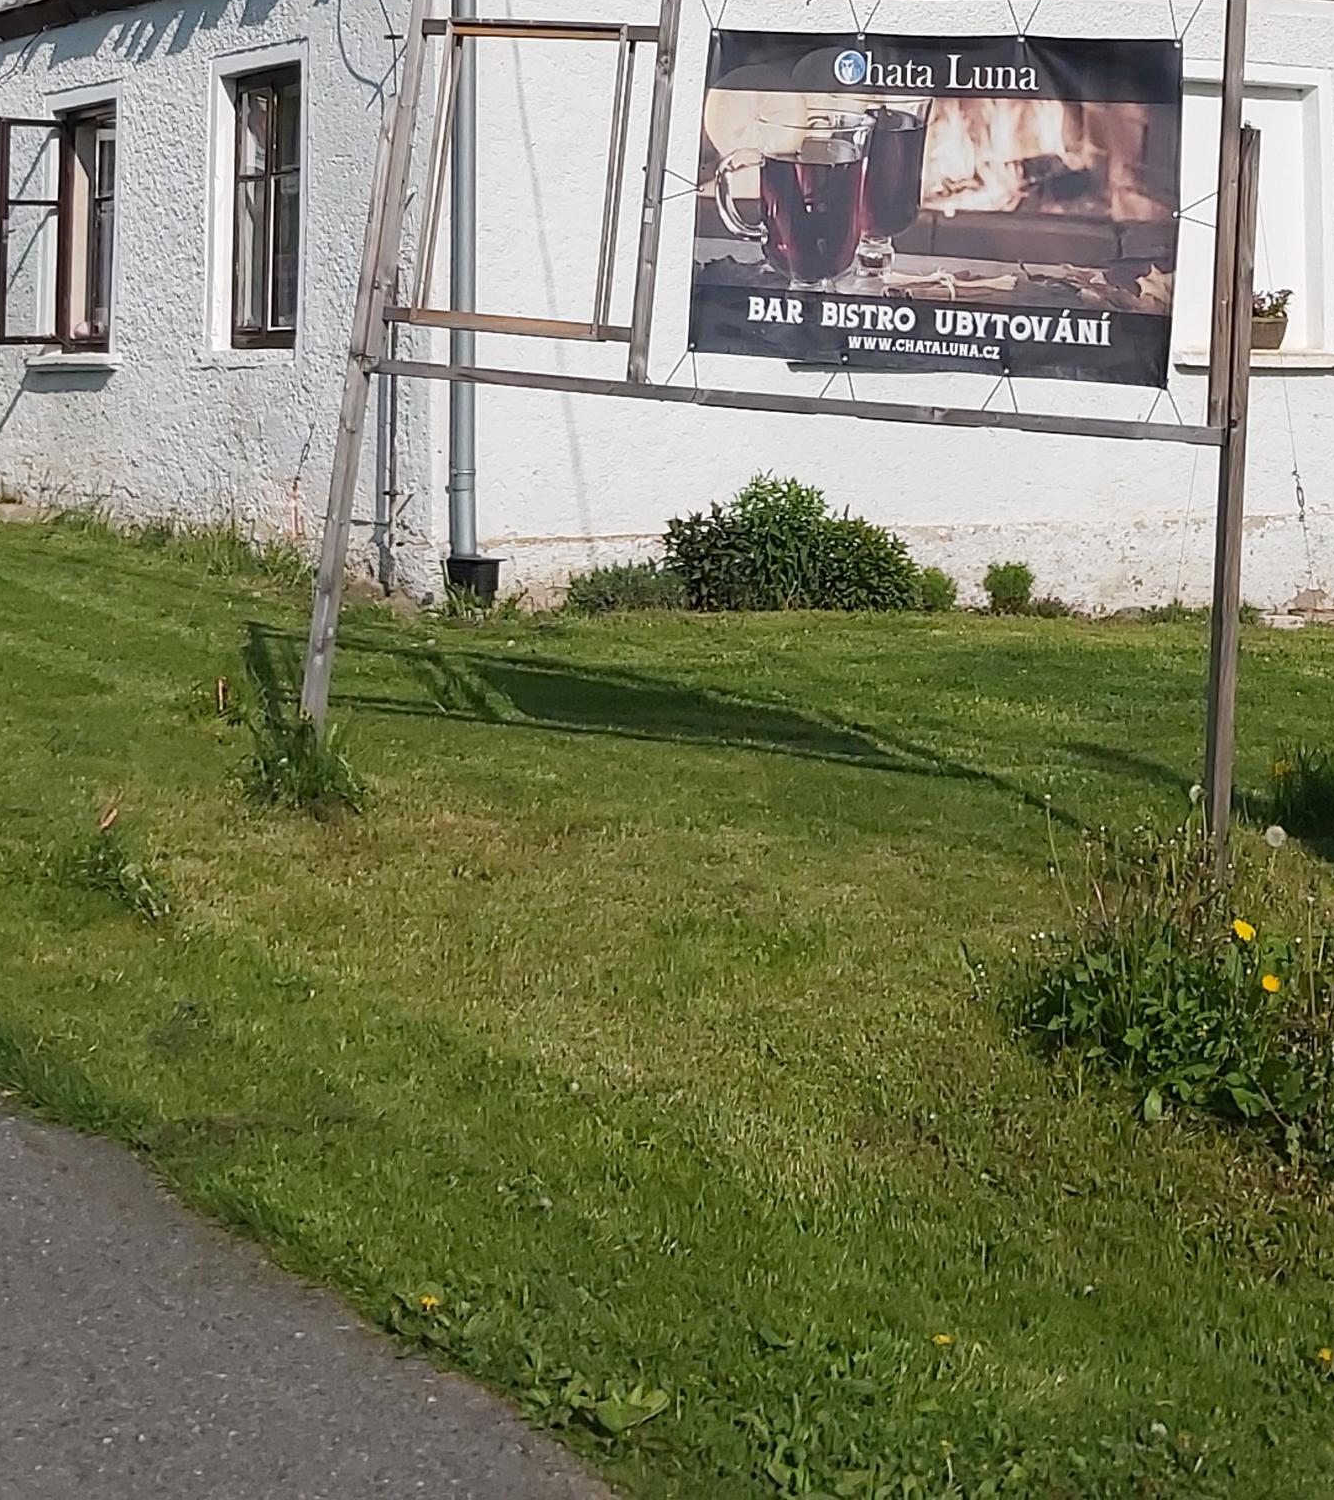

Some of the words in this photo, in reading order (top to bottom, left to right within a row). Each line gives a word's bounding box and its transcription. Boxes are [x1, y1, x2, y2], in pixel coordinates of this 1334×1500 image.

[945, 54, 1040, 91] Luna
[747, 296, 804, 324] BAR
[820, 301, 916, 332] BISTRO
[934, 309, 1112, 347] UBYTOVÁNÍ
[847, 335, 1001, 360] WWW.CHATALUNA.CZ
